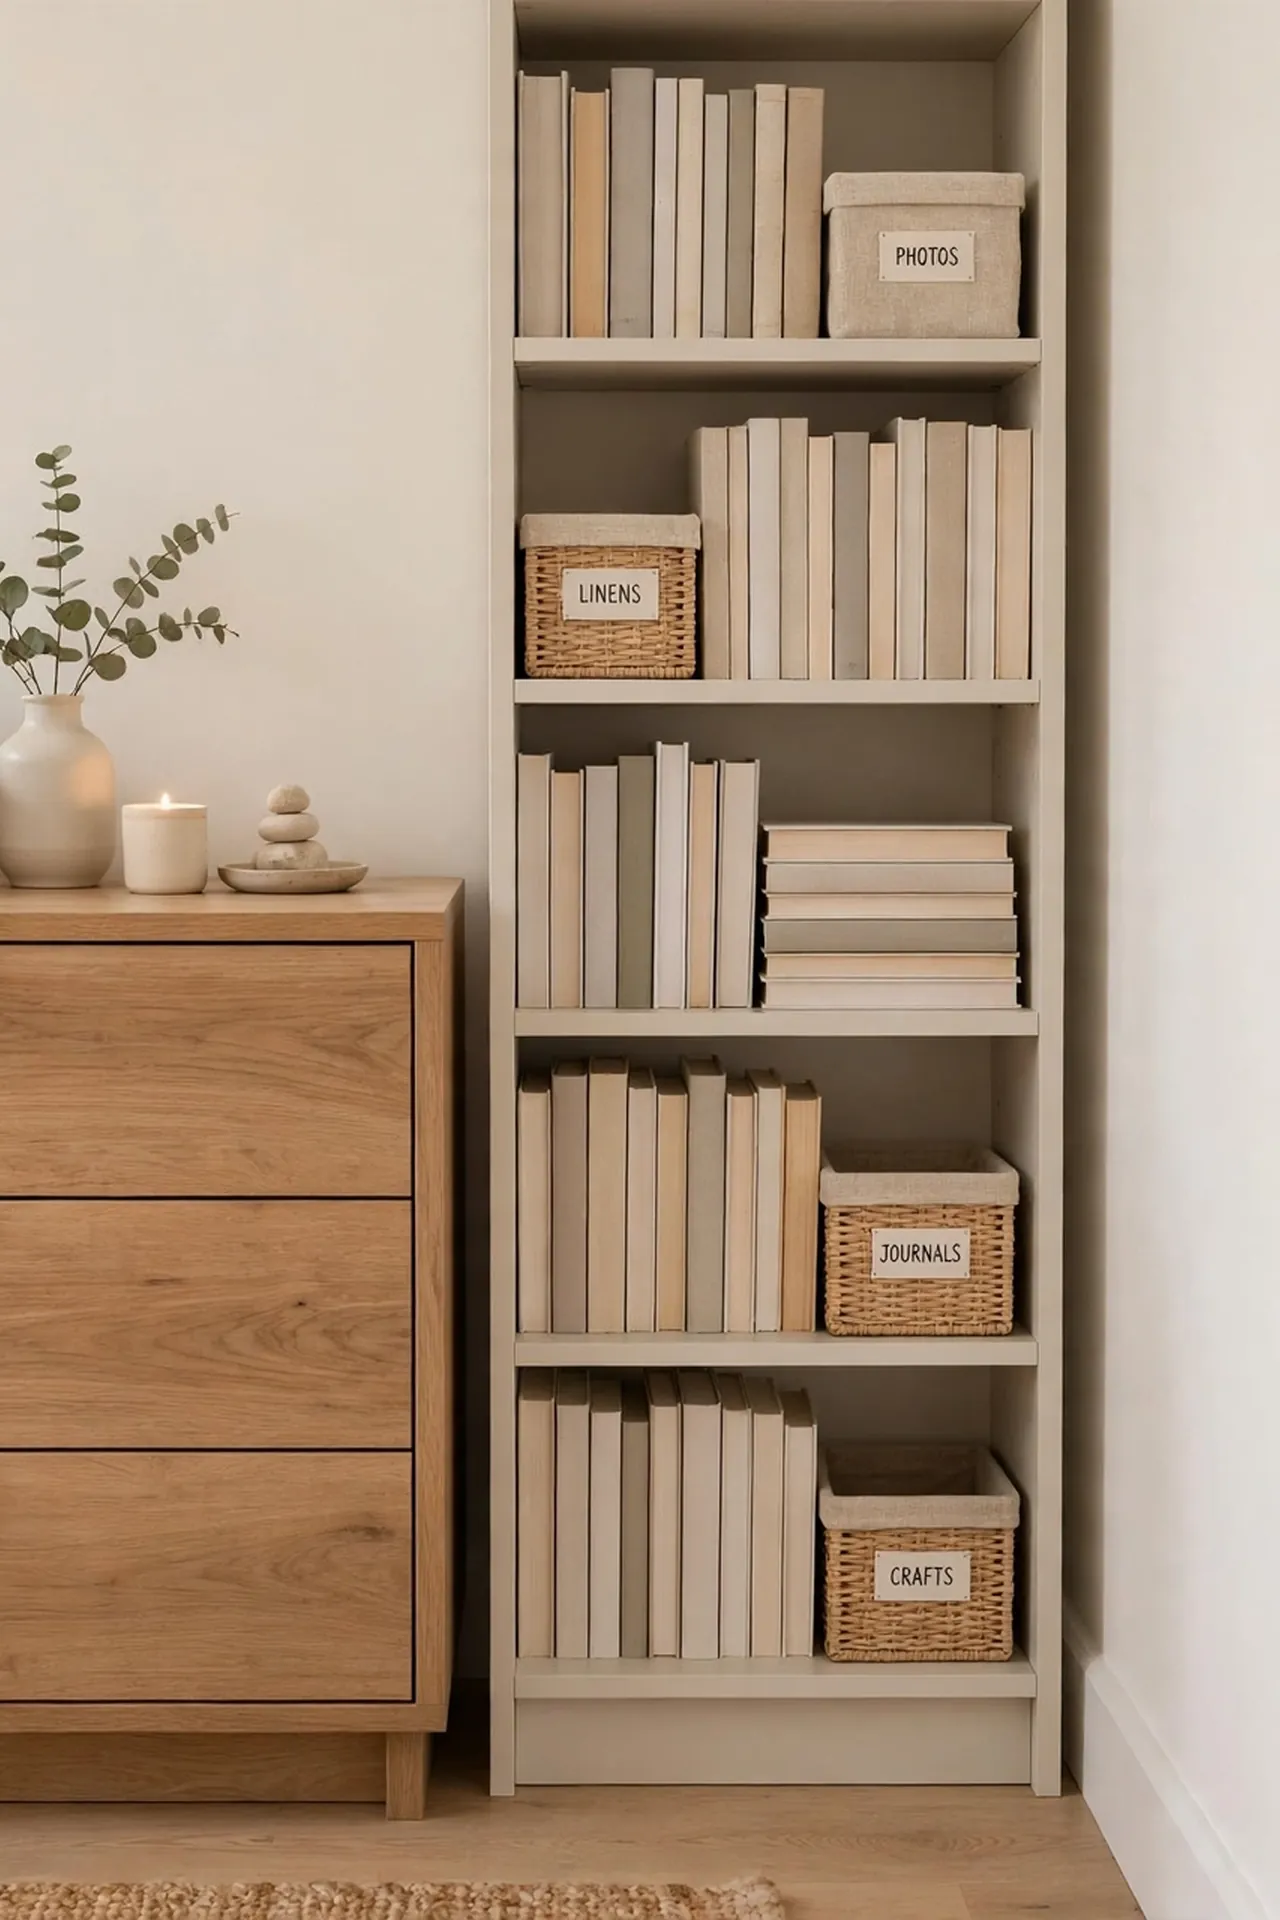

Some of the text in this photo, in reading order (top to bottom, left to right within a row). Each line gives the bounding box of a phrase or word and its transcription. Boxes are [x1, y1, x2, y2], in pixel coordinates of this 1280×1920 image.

[896, 246, 959, 267] PHOTOS
[579, 583, 642, 604] LINENS
[879, 1242, 962, 1264] JOURNALS
[890, 1566, 954, 1587] CRAFTS
